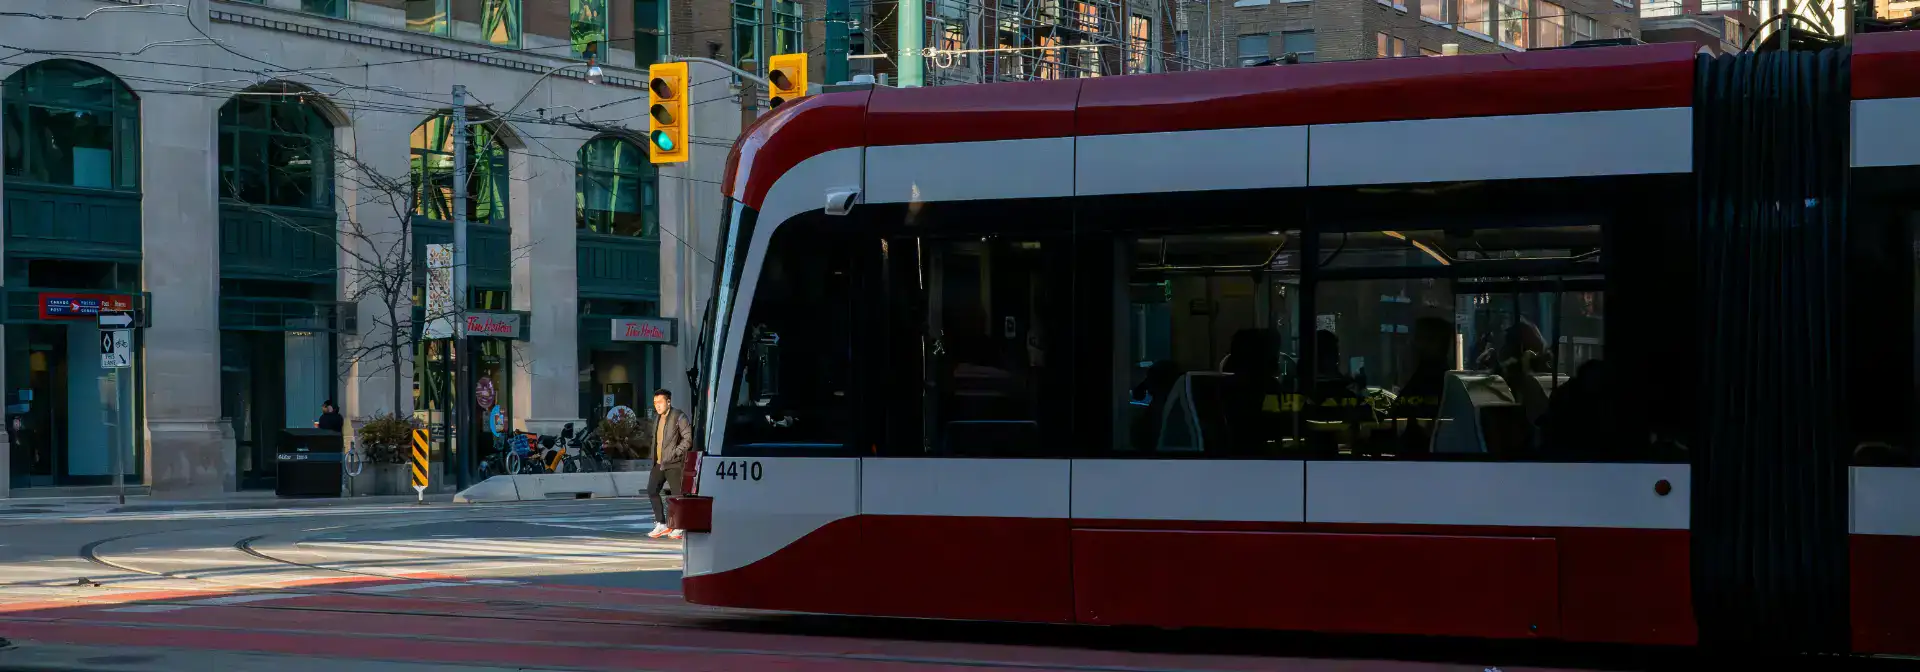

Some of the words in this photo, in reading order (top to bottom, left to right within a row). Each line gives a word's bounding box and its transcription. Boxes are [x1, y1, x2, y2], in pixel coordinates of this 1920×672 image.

[467, 315, 483, 333] Tim
[625, 322, 640, 337] Tim
[716, 461, 762, 481] 4410
